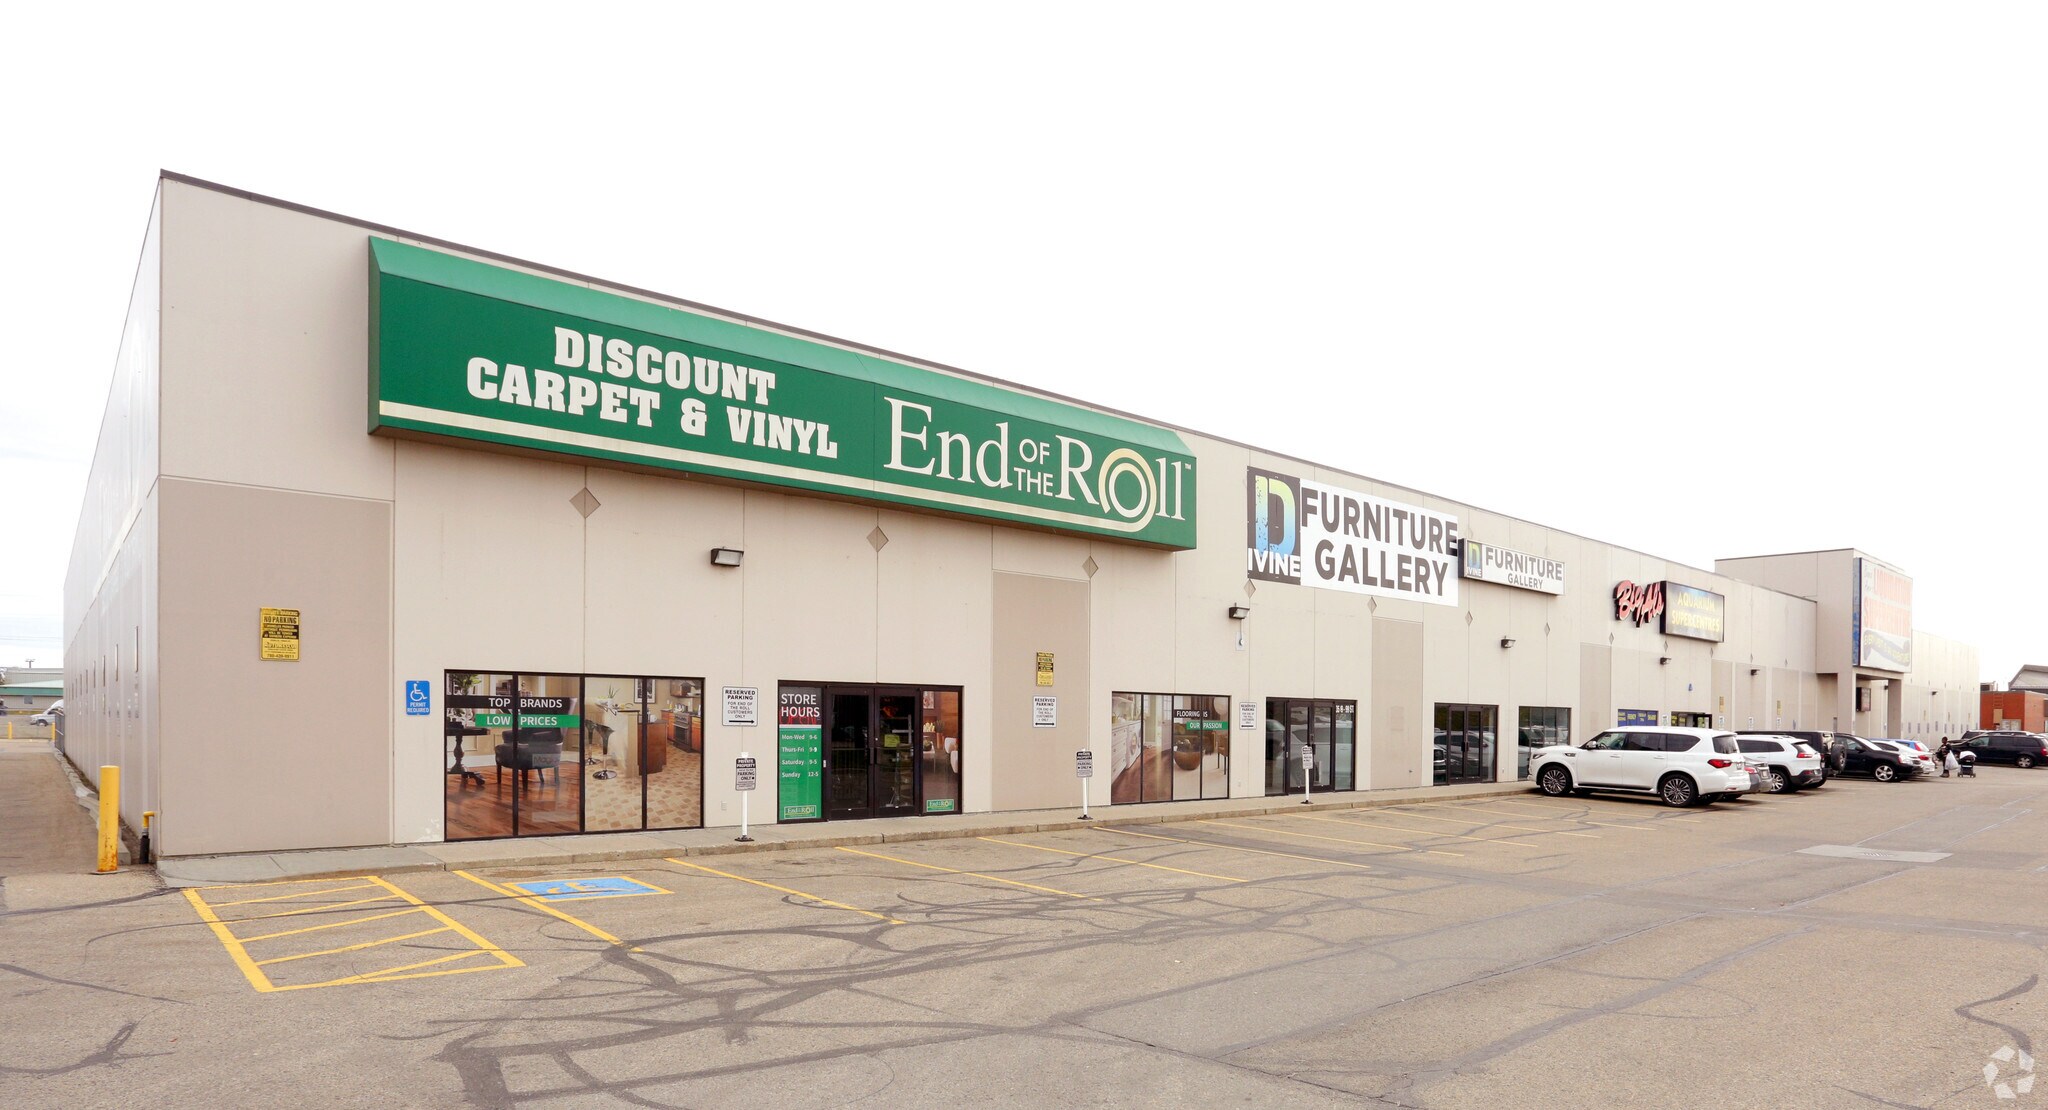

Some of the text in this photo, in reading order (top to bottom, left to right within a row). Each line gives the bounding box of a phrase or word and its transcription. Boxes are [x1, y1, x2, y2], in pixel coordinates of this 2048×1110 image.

[554, 326, 776, 406] DISCOUNT
[466, 356, 838, 459] CARPET & VINYL
[883, 396, 1013, 489] End
[1019, 438, 1050, 465] OF
[1013, 467, 1054, 497] THE
[1301, 486, 1458, 557] FURNITURE
[1314, 538, 1449, 597] GALLERY
[1486, 546, 1562, 581] FURNITURE
[1508, 573, 1544, 590] GALLERY
[488, 698, 562, 708] TOP BRANDS
[781, 694, 817, 705] STORE
[781, 706, 820, 717] HOURS
[486, 716, 558, 726] LOW PRICES
